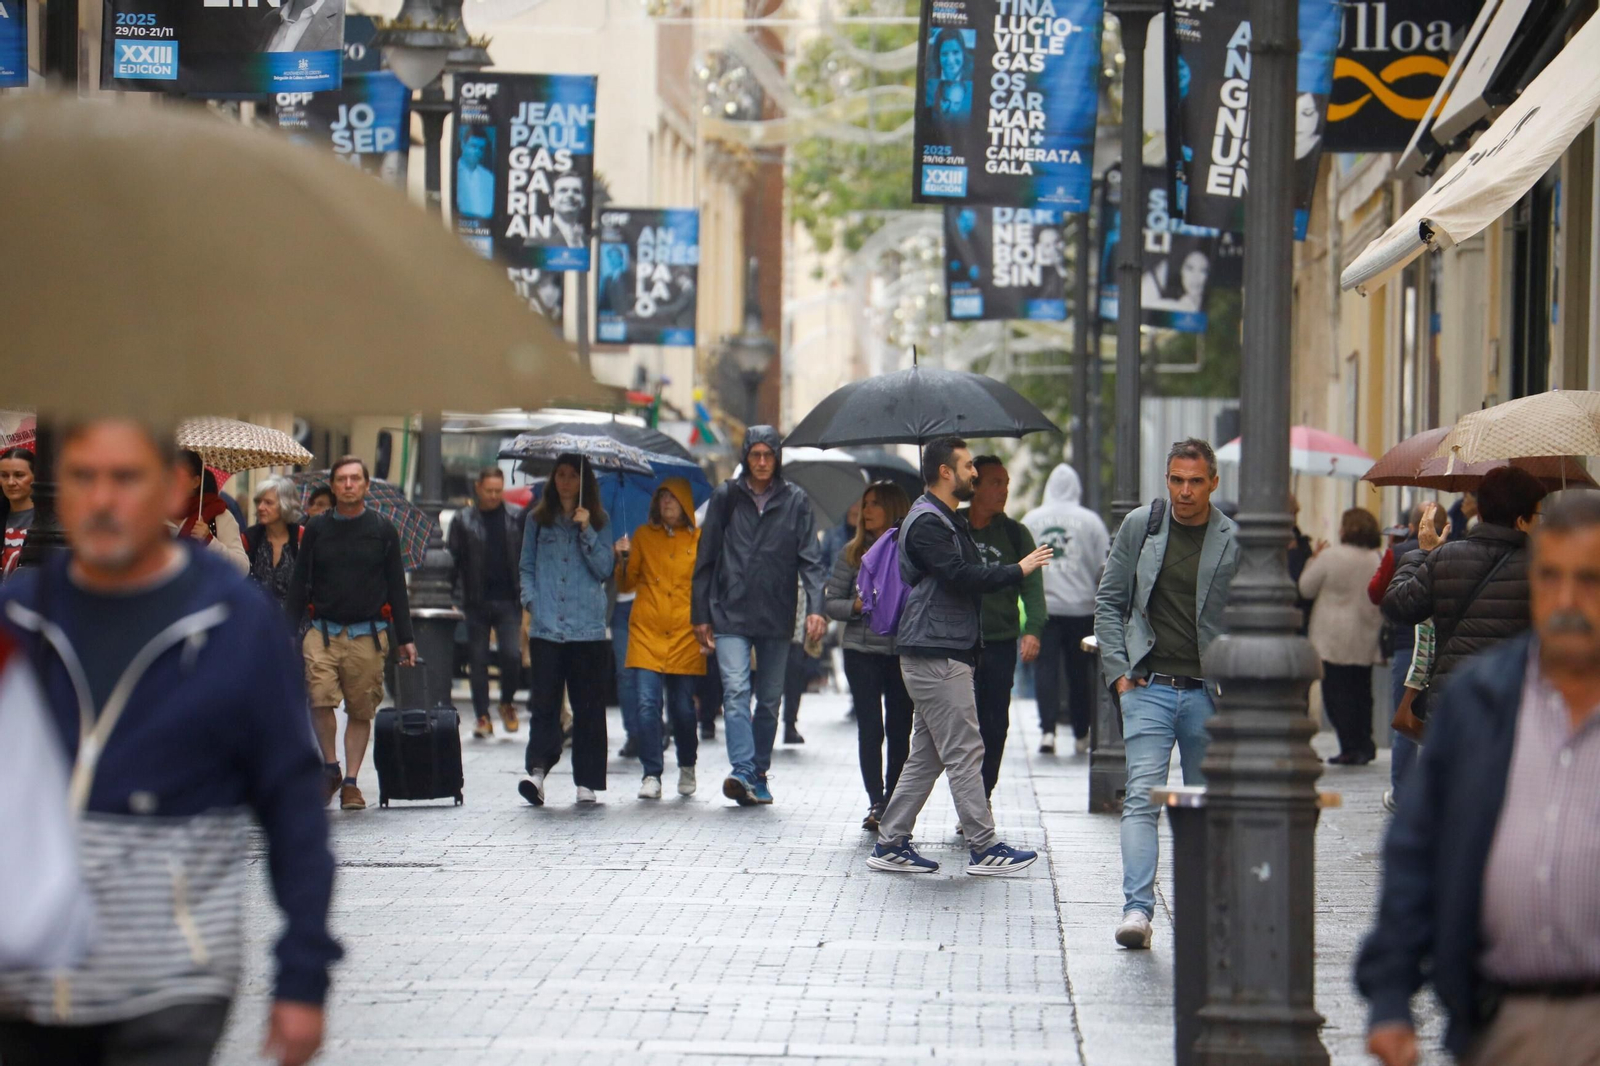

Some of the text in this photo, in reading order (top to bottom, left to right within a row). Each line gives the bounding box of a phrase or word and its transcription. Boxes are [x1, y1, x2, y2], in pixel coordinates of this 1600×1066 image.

[932, 12, 968, 20] FESTIVAL
[996, 0, 1056, 17] TINA
[116, 13, 156, 26] 2025
[994, 15, 1083, 37] LUCIO-
[115, 26, 174, 38] 29/10-21/11
[120, 45, 172, 64] XXIII
[993, 33, 1065, 55] VILLE
[119, 62, 171, 75] EDICIÓN
[991, 51, 1045, 73] GAS
[461, 82, 498, 99] OPF
[990, 72, 1027, 93] OS
[276, 91, 314, 106] OPF
[989, 91, 1043, 112] CAR
[330, 103, 375, 130] JO
[510, 102, 596, 126] JEAN-
[987, 109, 1046, 130] MAR
[331, 127, 396, 154] SEP
[510, 124, 585, 149] PAUL
[986, 127, 1045, 147] TIN+
[508, 147, 573, 172] GAS
[922, 155, 966, 165] 29/10-21/11
[923, 145, 953, 156] 2025
[985, 146, 1082, 165] CAMERATA
[925, 169, 964, 185] XXIII
[984, 161, 1034, 176] GALA
[508, 169, 551, 194] PA
[507, 192, 538, 217] RI
[505, 214, 550, 239] AN
[637, 225, 675, 246] AN
[992, 222, 1034, 245] NE
[636, 262, 672, 283] PA
[992, 263, 1043, 288] SIN
[635, 281, 670, 301] LA
